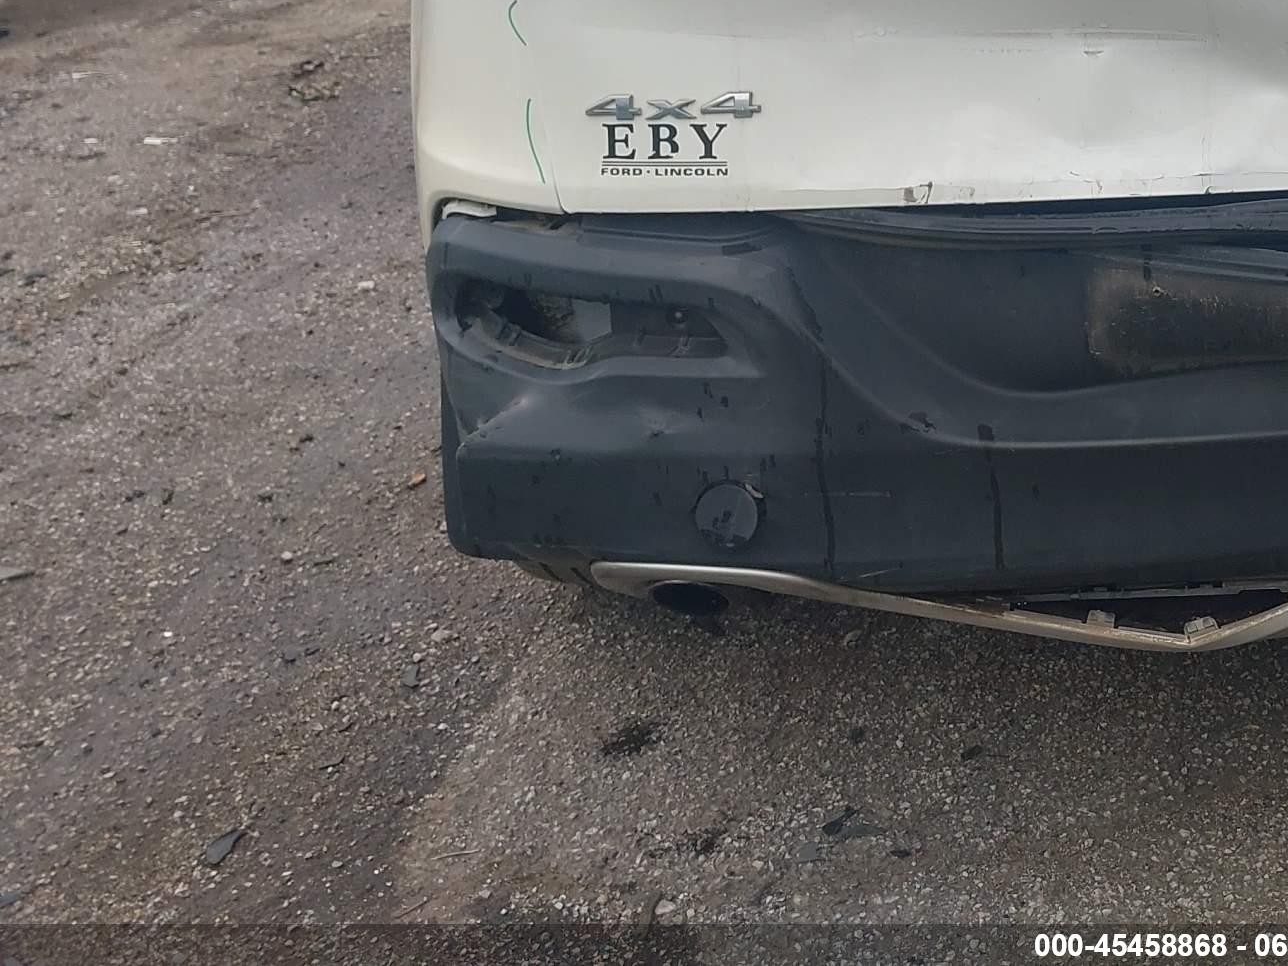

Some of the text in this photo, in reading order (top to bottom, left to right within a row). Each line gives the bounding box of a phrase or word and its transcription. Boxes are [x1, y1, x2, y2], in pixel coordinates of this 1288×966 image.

[602, 123, 728, 160] EBY
[600, 167, 729, 177] FORD LINCOLN
